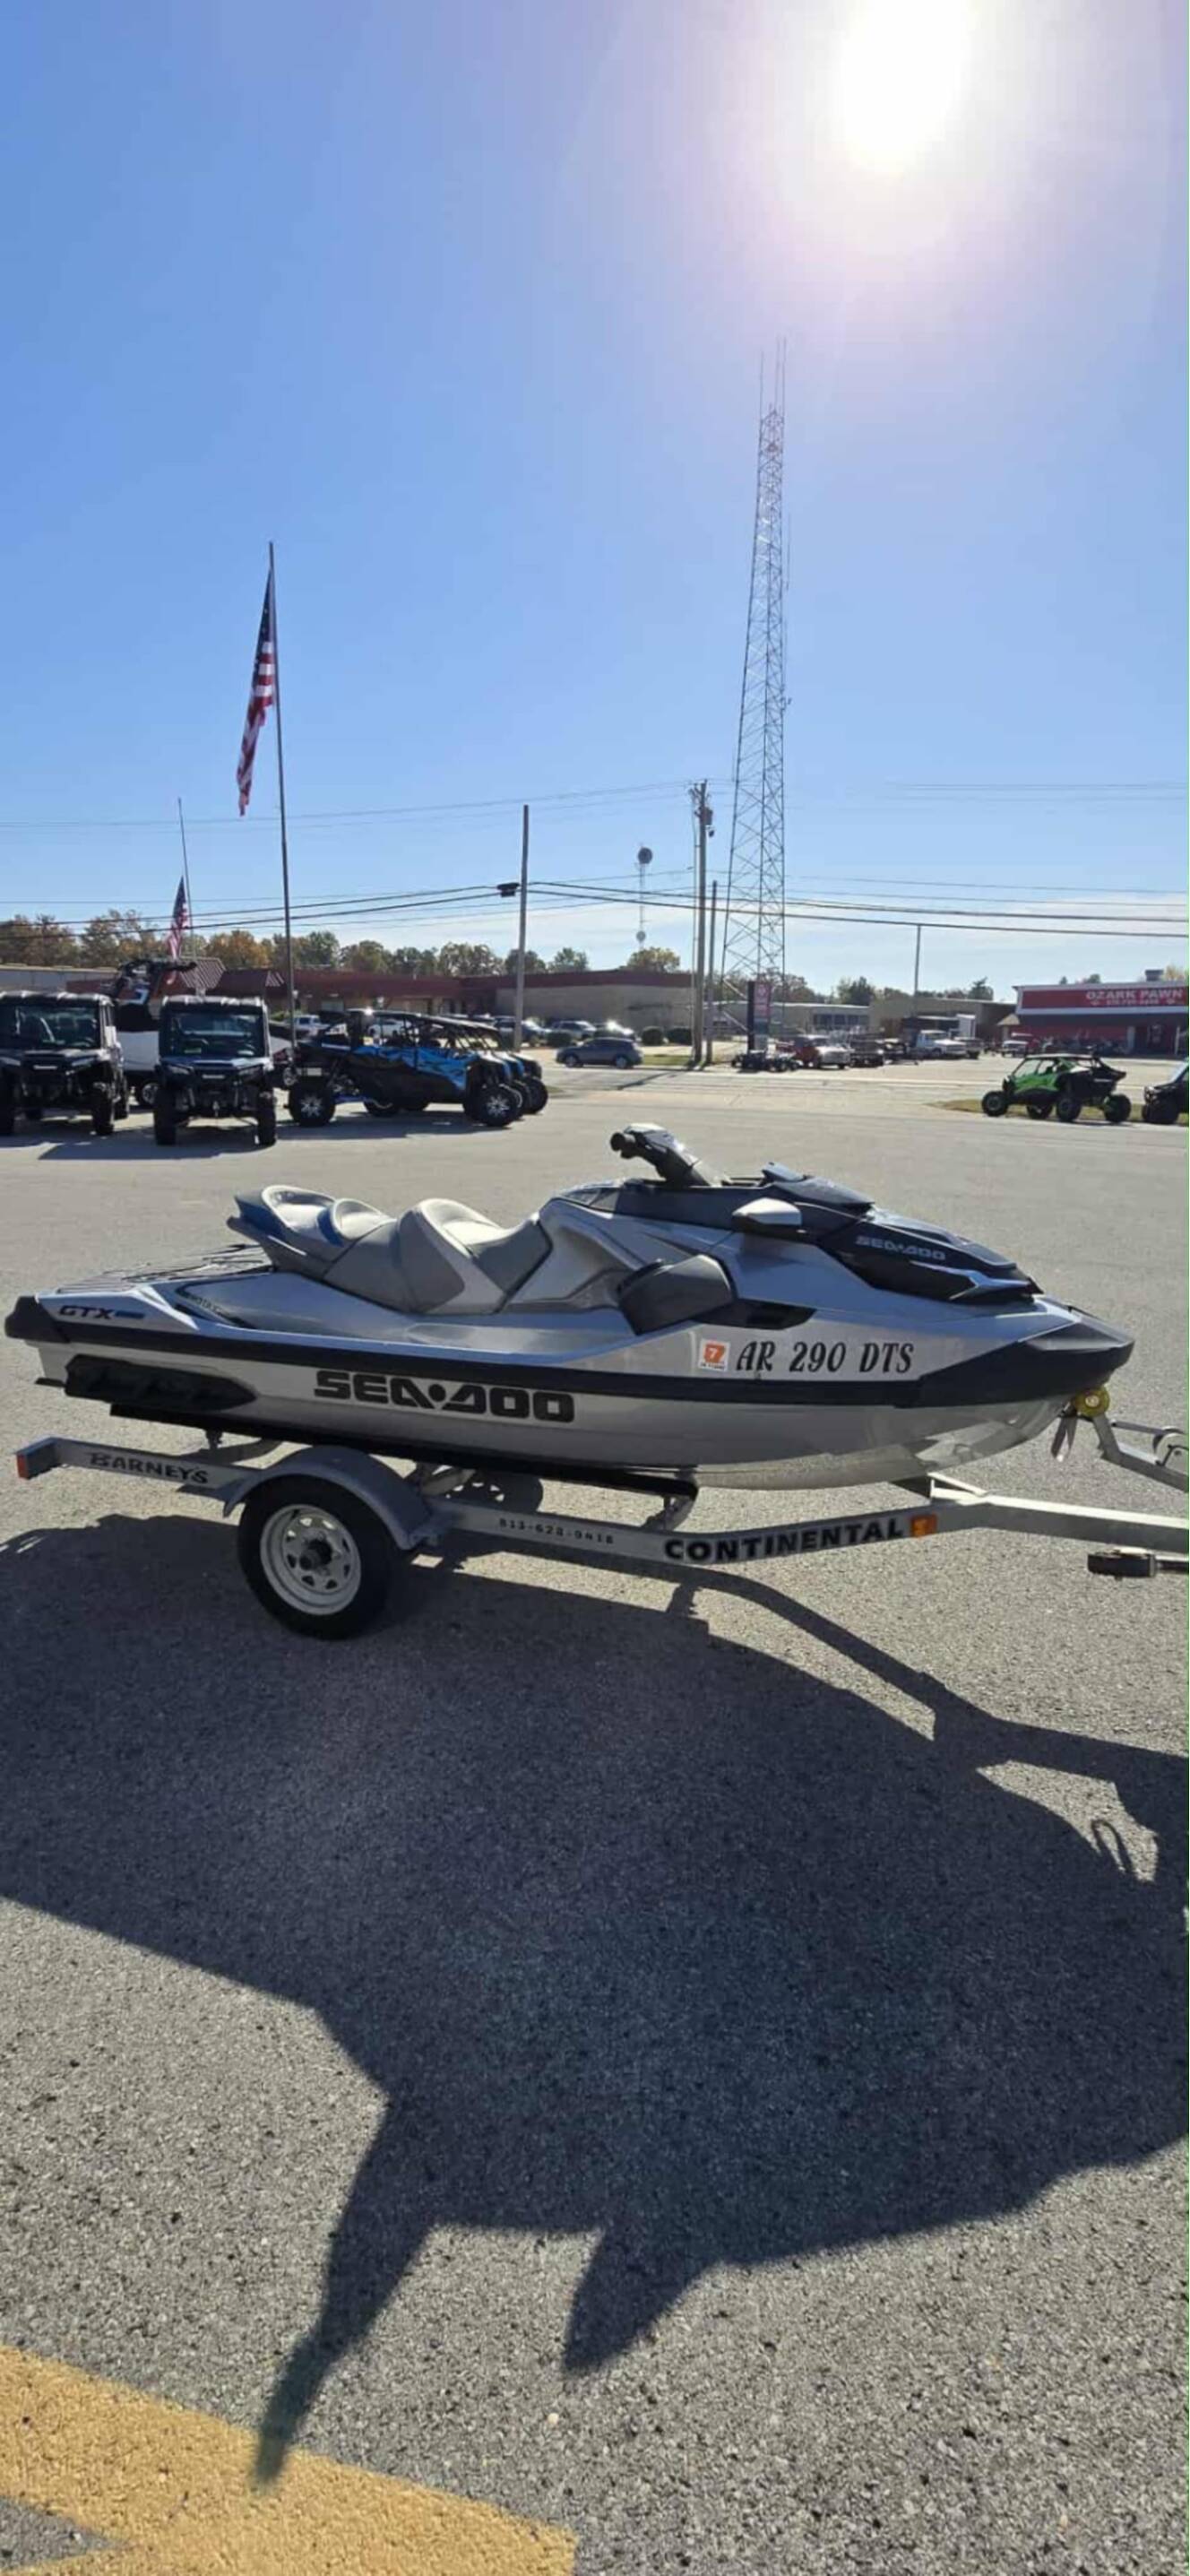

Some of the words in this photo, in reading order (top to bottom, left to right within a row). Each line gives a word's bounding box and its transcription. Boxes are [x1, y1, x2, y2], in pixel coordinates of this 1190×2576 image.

[1086, 990, 1135, 1000] OZARK
[1140, 989, 1183, 999] PAWN
[59, 1304, 112, 1320] GTX
[736, 1341, 776, 1372] AR
[789, 1342, 847, 1373] 290
[859, 1343, 914, 1373] DTS
[664, 1518, 904, 1561] CONTINENTAL
